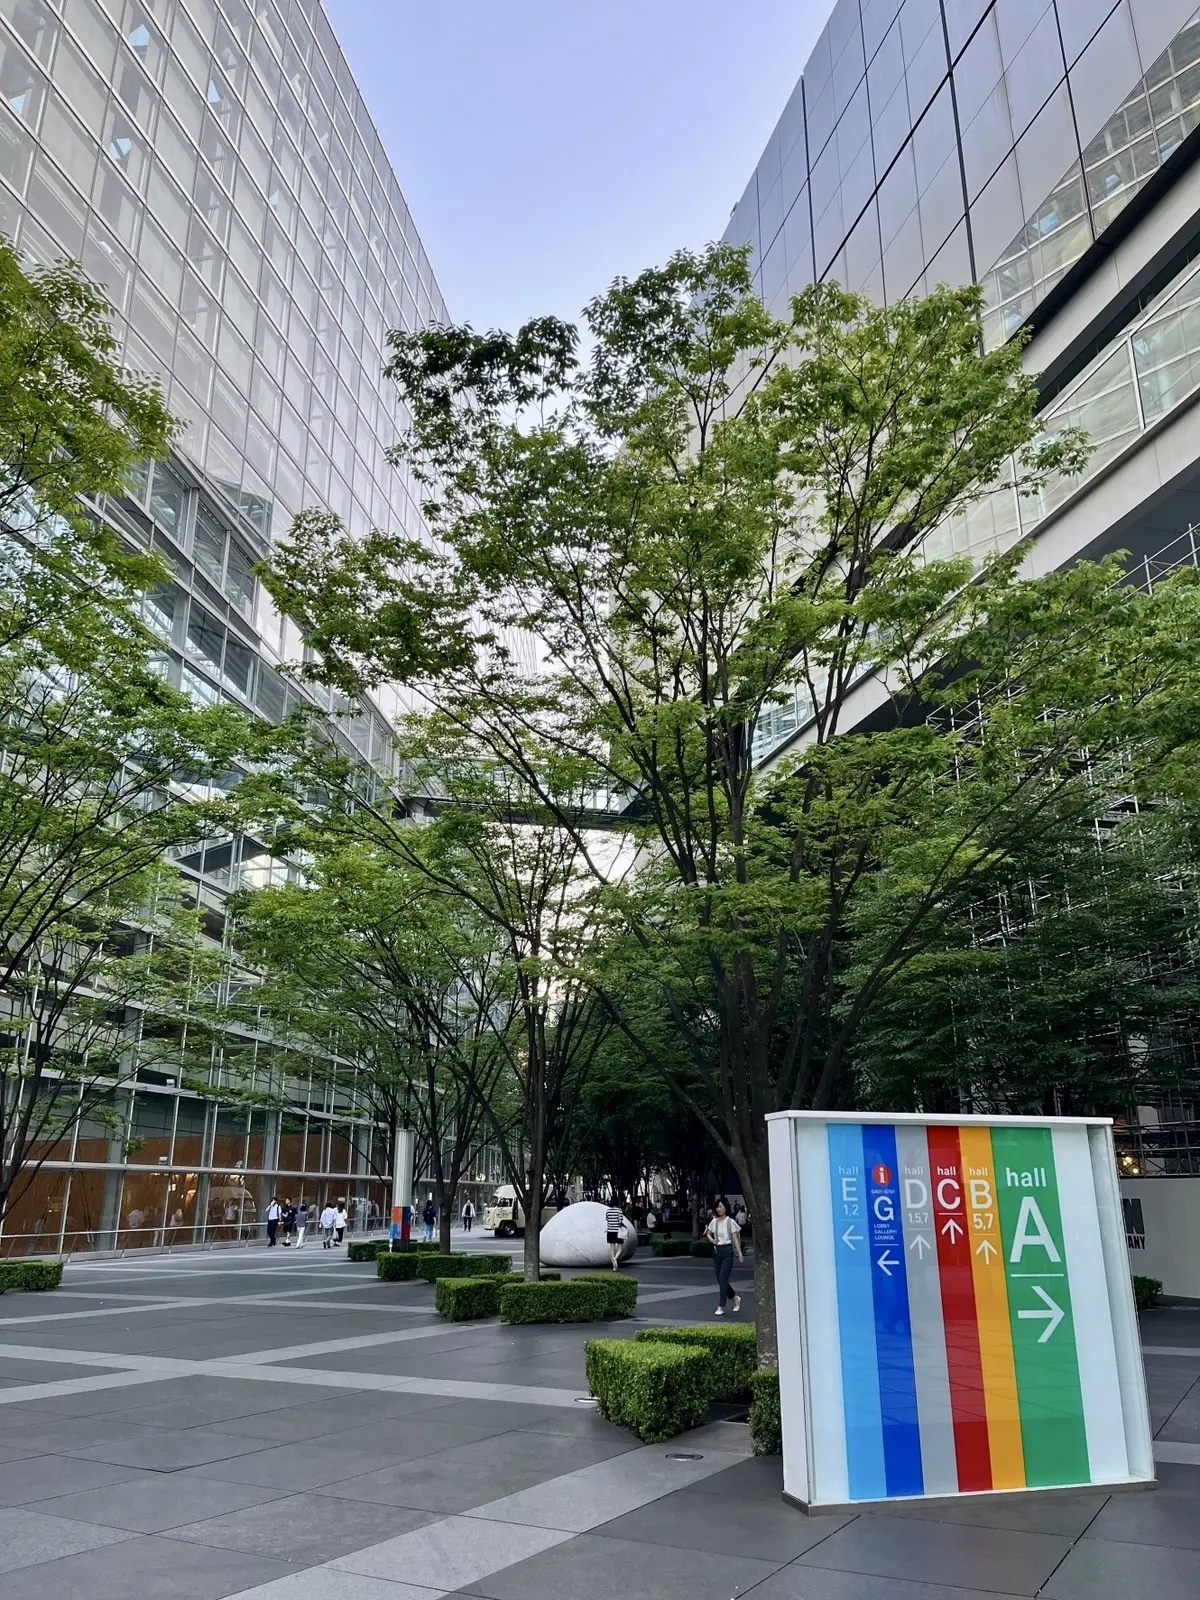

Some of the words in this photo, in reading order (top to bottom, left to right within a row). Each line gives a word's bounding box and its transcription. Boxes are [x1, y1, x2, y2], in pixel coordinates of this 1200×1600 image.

[838, 1166, 859, 1176] hall
[878, 1166, 887, 1184] i
[904, 1166, 924, 1176] hall
[937, 1166, 957, 1176] hall
[969, 1166, 988, 1176] hall
[1006, 1167, 1046, 1187] hall
[842, 1178, 858, 1202] E
[905, 1179, 927, 1209] D
[937, 1178, 961, 1210] C
[970, 1179, 993, 1209] B
[843, 1204, 860, 1217] 1,2
[874, 1195, 895, 1221] G
[907, 1212, 929, 1224] 1,5,7
[973, 1213, 994, 1230] 5,7
[1009, 1196, 1061, 1263] A
[1127, 1235, 1146, 1249] ANY
